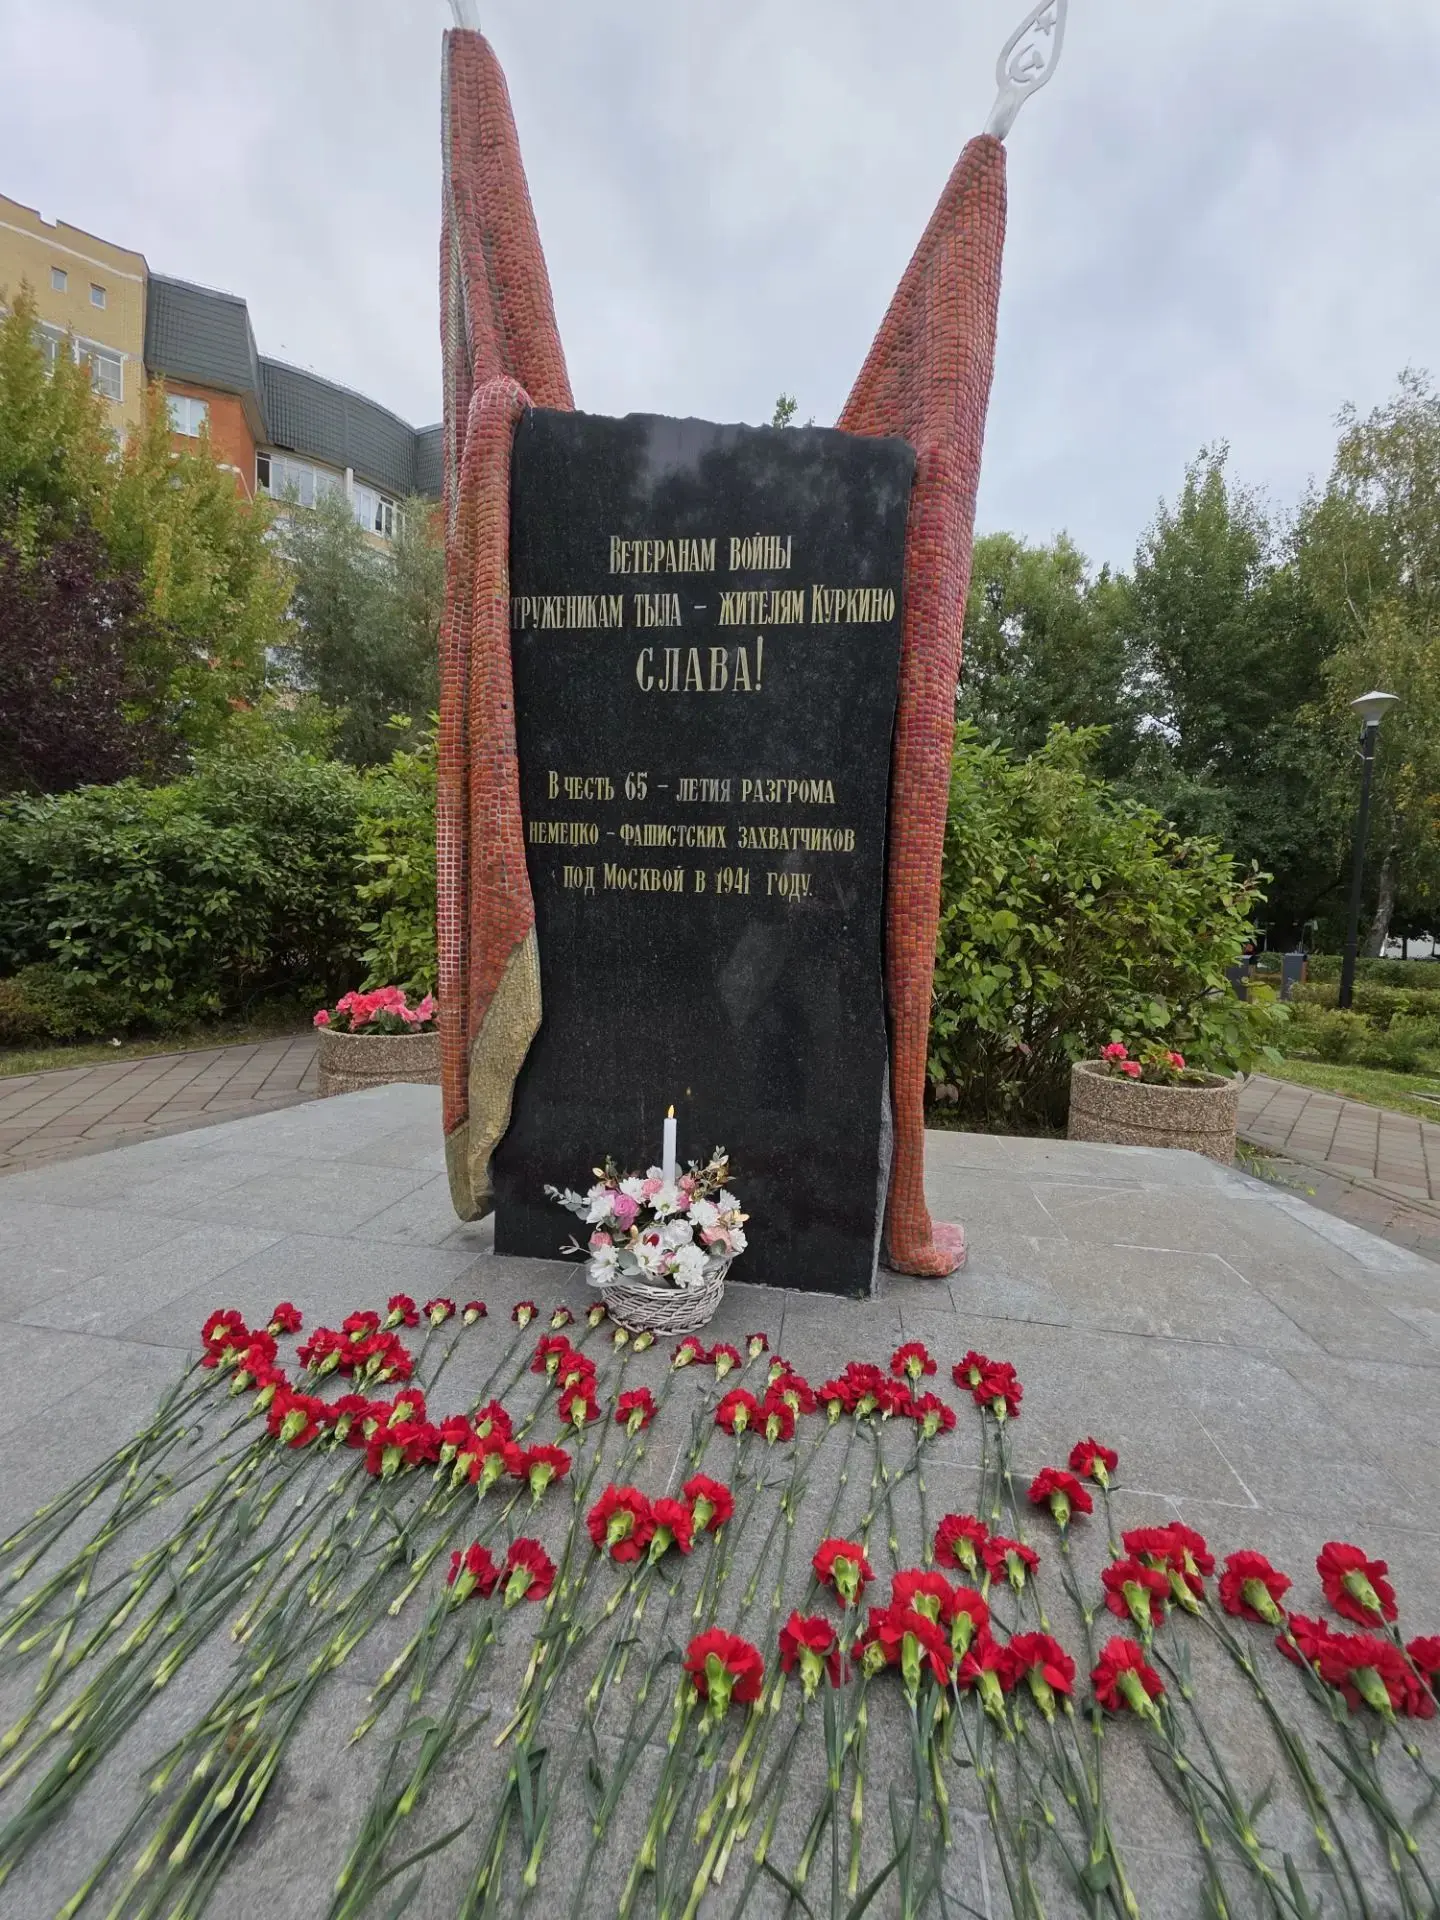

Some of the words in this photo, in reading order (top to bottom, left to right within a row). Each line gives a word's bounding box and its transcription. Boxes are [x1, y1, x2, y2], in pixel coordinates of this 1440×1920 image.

[609, 536, 717, 574] ВЕТЕРАНАМ
[729, 532, 791, 571] ВОЙНЫ
[511, 594, 624, 629] ТРУЖЕНИКАМ
[634, 593, 682, 628] ТЫЛА
[718, 589, 805, 626] ЖИТЕЛЯМ
[811, 584, 895, 625] КУРКИНО
[636, 636, 764, 692] СЛАВА!
[548, 771, 559, 800] В
[564, 776, 615, 801] ЧЕСТЬ
[625, 771, 648, 801] 65
[676, 778, 731, 802] ЛЕТИЯ
[742, 779, 835, 803] РАЗГРОМА
[529, 822, 599, 846] НЕМЕЦКО
[620, 824, 726, 848] ФАШИСТСКИХ
[738, 826, 855, 851] ЗАХВАТЧИКОВ
[563, 865, 595, 895] ПОД
[604, 864, 684, 893] МОСКВОЙ
[695, 870, 706, 893] В
[716, 867, 750, 894] 1941
